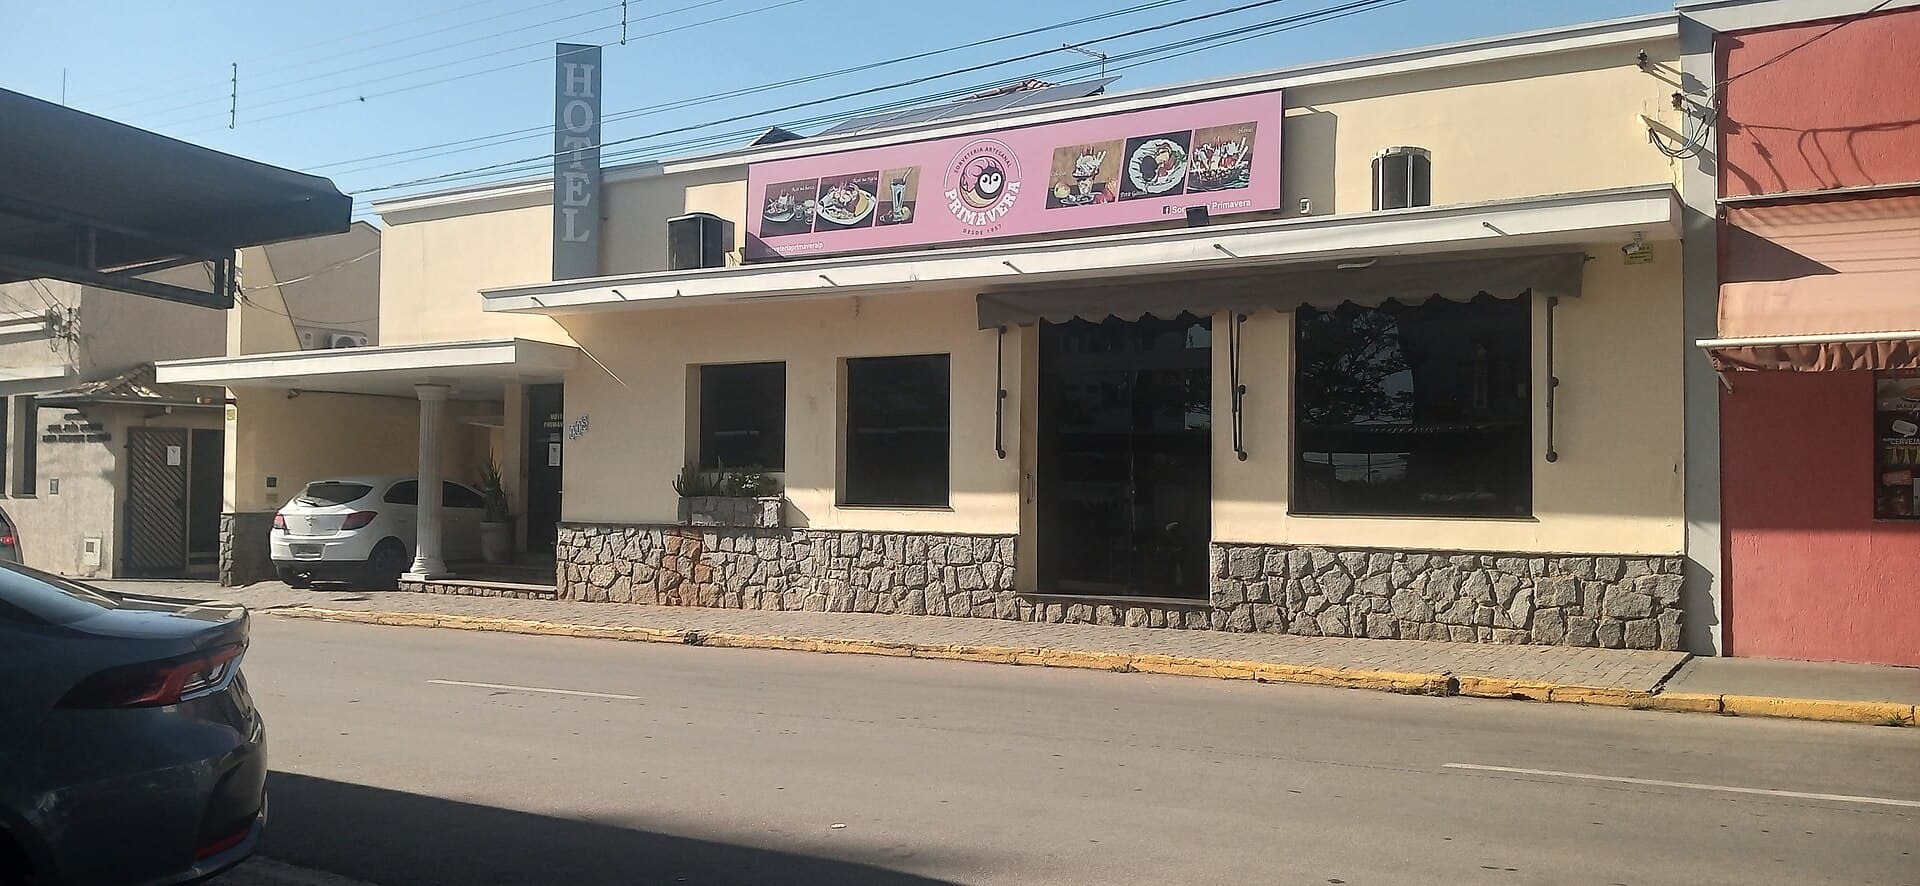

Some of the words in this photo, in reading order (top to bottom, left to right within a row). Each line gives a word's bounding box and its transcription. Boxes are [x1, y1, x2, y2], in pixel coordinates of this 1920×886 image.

[562, 62, 595, 243] HOTEL
[953, 147, 984, 174] SORVETERIA
[984, 146, 1012, 169] ARTESANAL
[944, 180, 1021, 226] PRIMAVERA
[1211, 200, 1251, 210] Primavera
